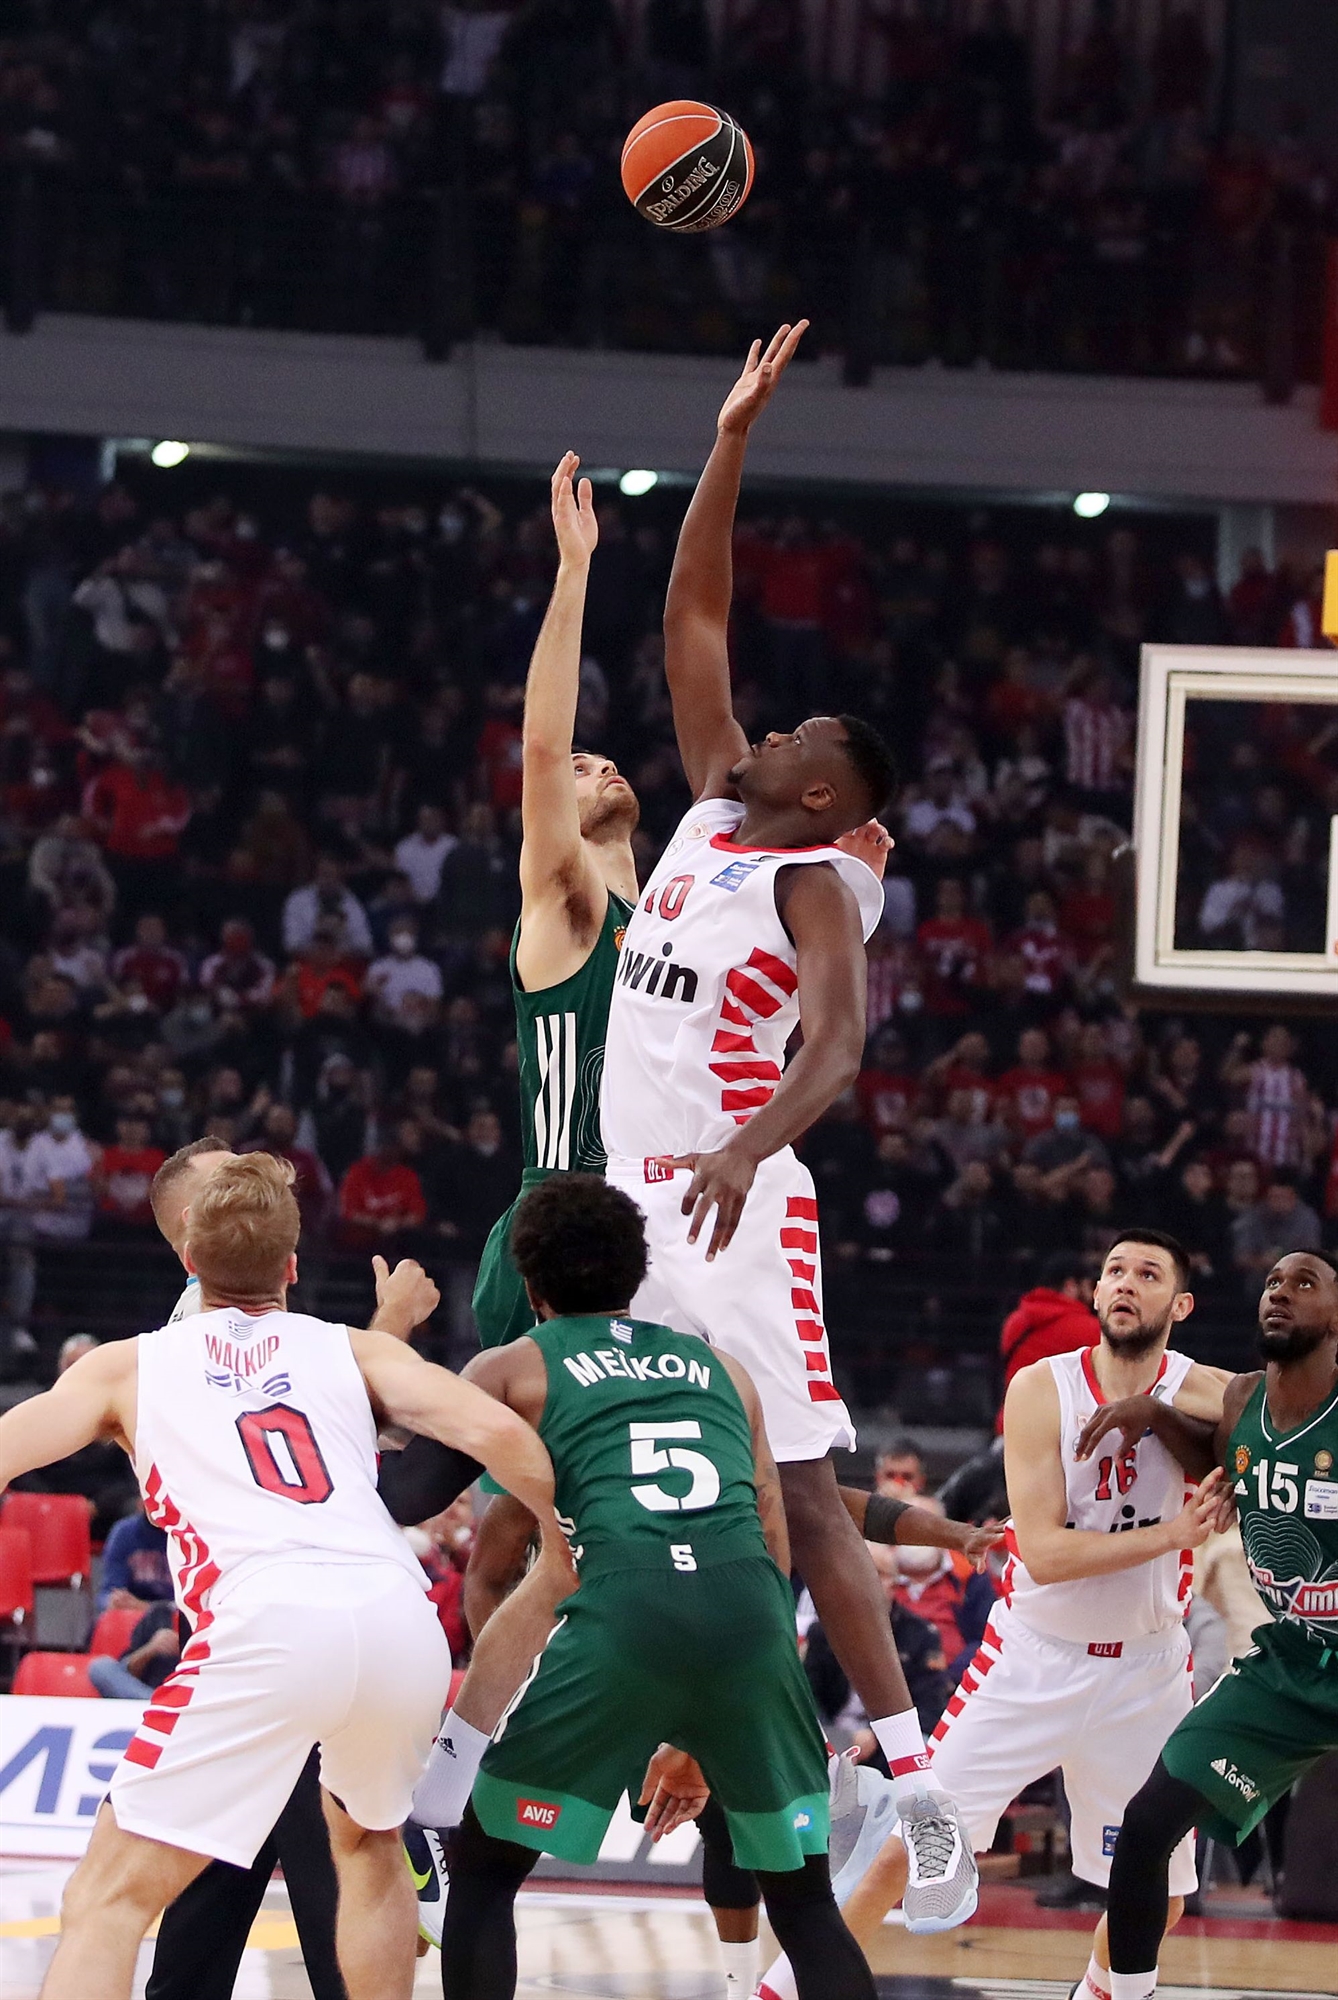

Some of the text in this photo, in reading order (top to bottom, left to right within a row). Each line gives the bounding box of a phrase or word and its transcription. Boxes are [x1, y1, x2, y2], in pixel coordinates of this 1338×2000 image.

[646, 156, 720, 221] SPALDING
[619, 941, 698, 1003] win
[205, 1333, 280, 1377] WALKUP
[235, 1401, 335, 1505] 0
[629, 1420, 721, 1511] 5
[1095, 1447, 1138, 1501] 16
[1252, 1458, 1299, 1514] 15
[670, 1544, 697, 1571] 5
[523, 1805, 555, 1824] AVIS
